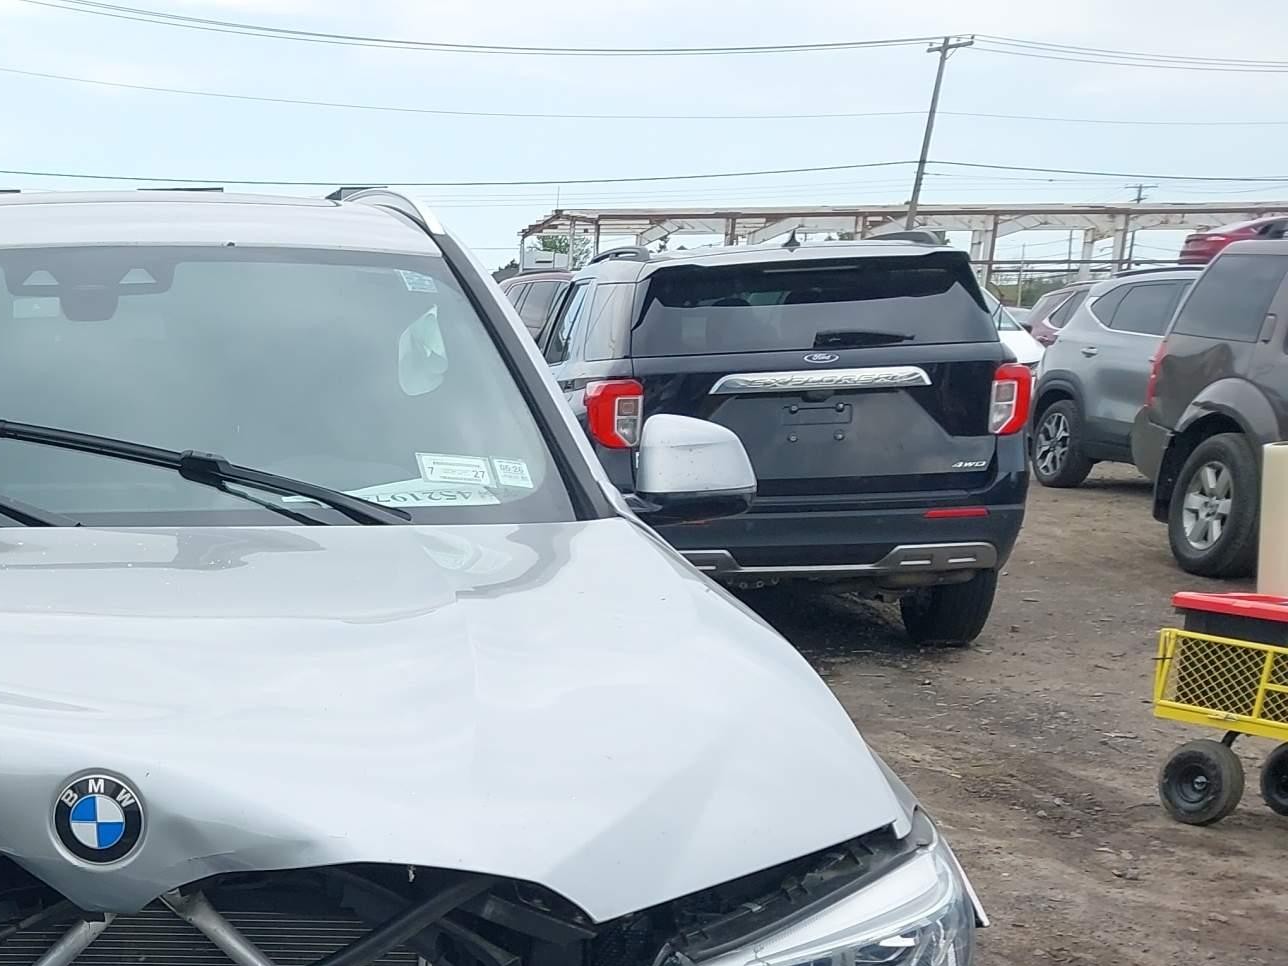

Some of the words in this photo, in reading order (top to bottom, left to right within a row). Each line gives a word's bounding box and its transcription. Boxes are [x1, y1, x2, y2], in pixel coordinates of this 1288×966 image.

[747, 374, 902, 389] EXPLORER
[951, 460, 987, 468] 4WD
[60, 778, 136, 808] BMW
